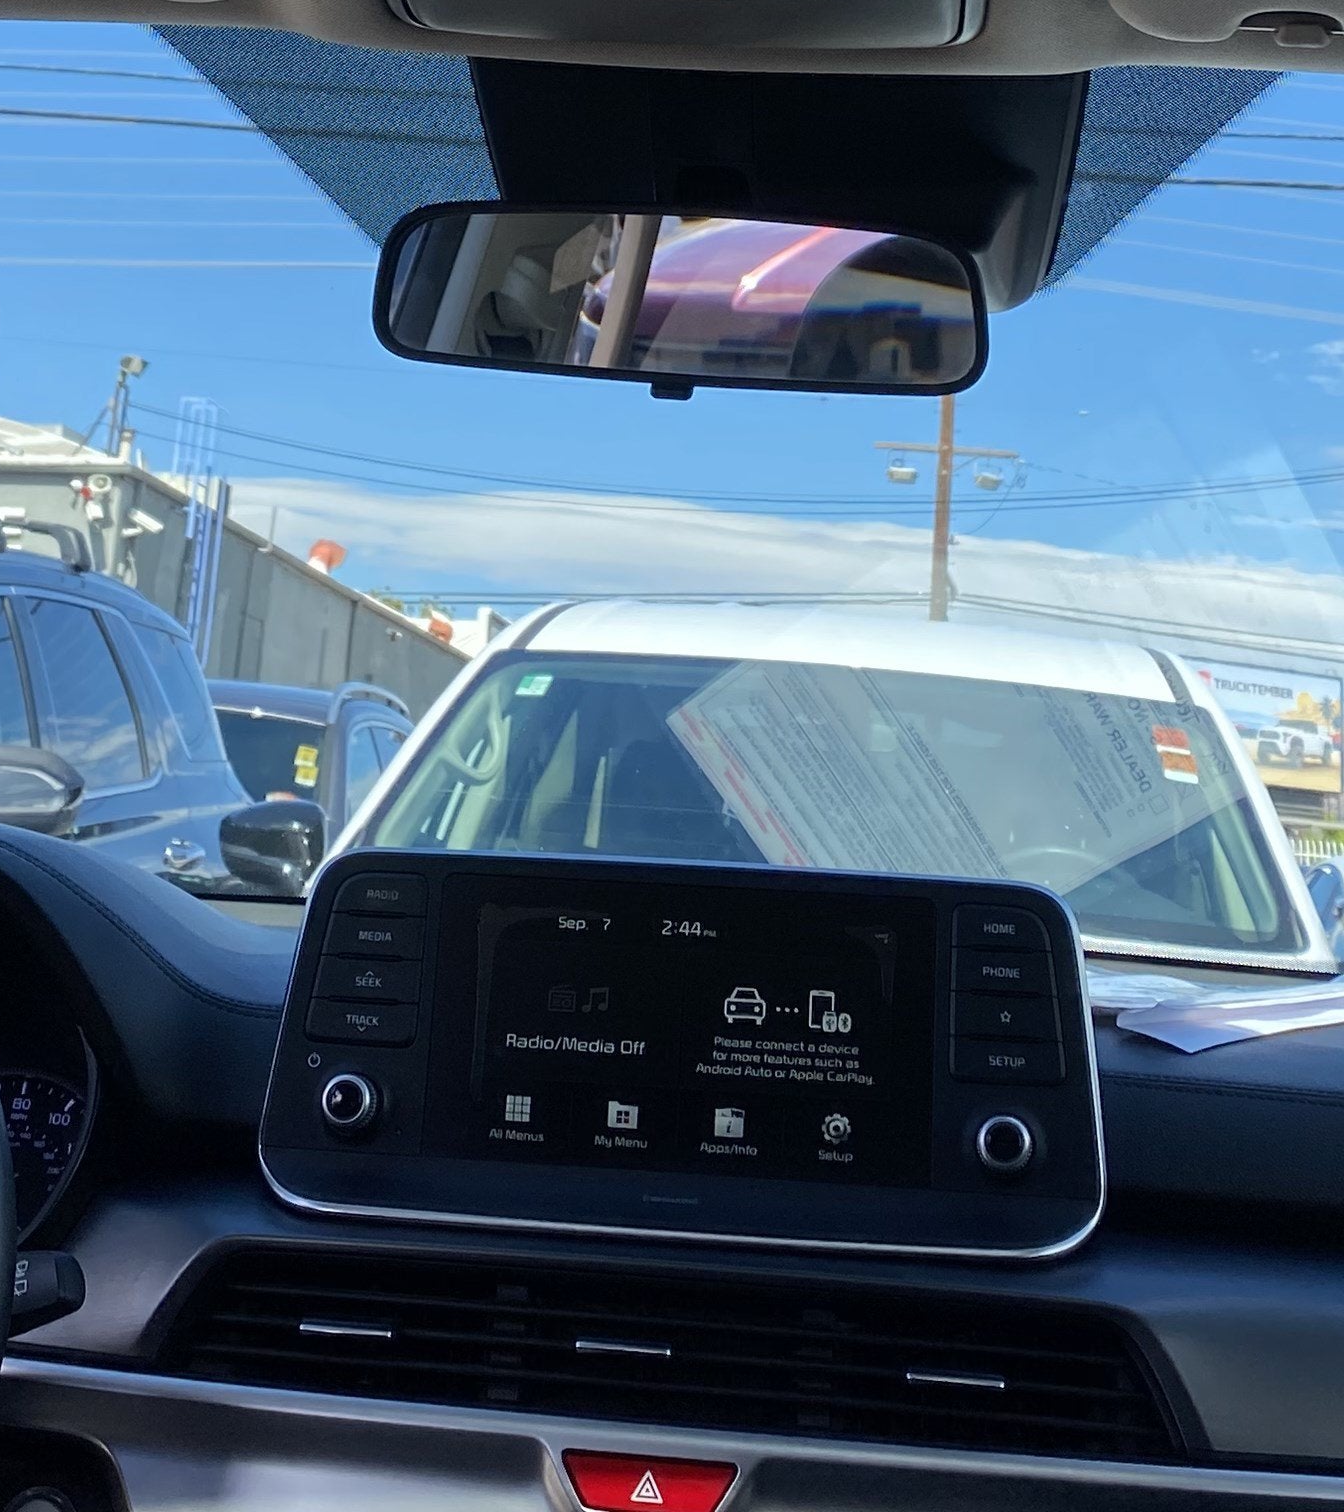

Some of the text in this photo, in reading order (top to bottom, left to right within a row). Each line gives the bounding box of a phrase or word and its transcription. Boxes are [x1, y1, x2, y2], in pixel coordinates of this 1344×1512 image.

[366, 889, 399, 901] RADIO
[558, 916, 611, 931] Sep. 7
[662, 920, 702, 936] 2:44
[983, 923, 1016, 935] HOME
[358, 930, 392, 942] MEDIA
[982, 966, 1021, 979] PHONE
[354, 976, 383, 988] SEEK
[345, 1013, 380, 1026] TRACK
[506, 1033, 646, 1055] Radio/Media Off
[714, 1035, 860, 1055] Please connect a device
[712, 1050, 860, 1069] for more features such as
[988, 1055, 1026, 1068] SETUP
[695, 1063, 742, 1077] Android
[744, 1065, 773, 1079] Auto
[774, 1068, 787, 1079] or
[789, 1068, 824, 1083] Apple
[12, 1098, 32, 1110] 80
[48, 1112, 71, 1127] 100
[489, 1129, 545, 1143] All Menus
[594, 1135, 649, 1150] My Menu
[699, 1141, 758, 1157] Apps/Info
[818, 1149, 853, 1163] Setup
